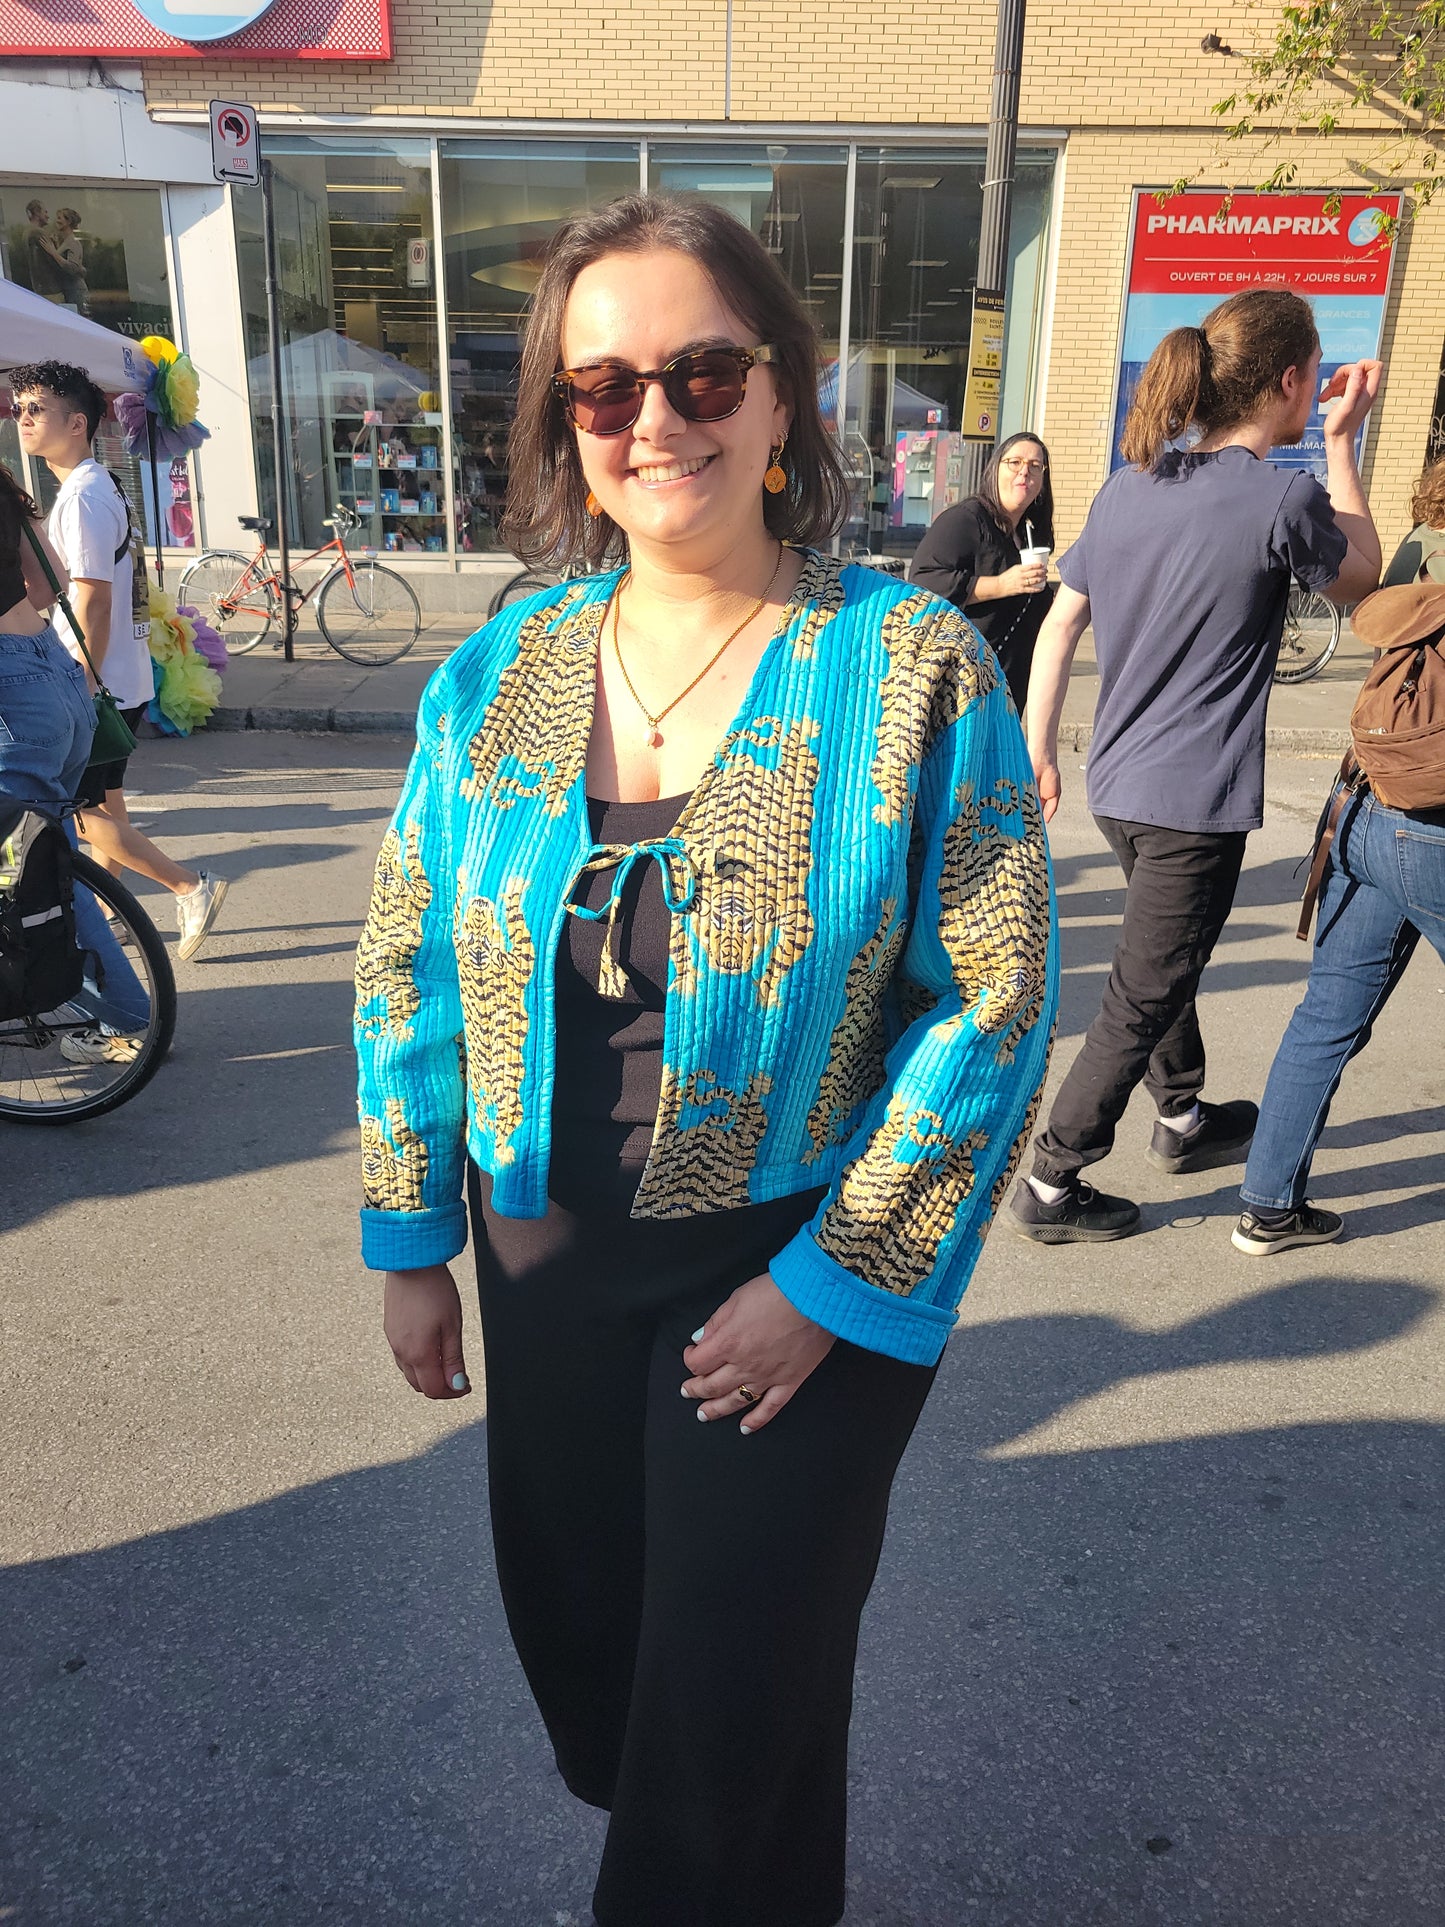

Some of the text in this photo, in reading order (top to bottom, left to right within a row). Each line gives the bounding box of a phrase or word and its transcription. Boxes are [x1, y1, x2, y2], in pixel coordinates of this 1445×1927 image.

[1147, 215, 1341, 236] PHARMAPRIX
[1169, 272, 1217, 282] OUVERT
[1218, 272, 1234, 282] DE
[1236, 272, 1251, 282] 9H
[1264, 272, 1285, 283] 22H
[1294, 273, 1301, 283] 7
[1303, 273, 1341, 283] JOURS
[1343, 273, 1367, 283] SUR
[1370, 273, 1377, 283] 7
[1323, 343, 1369, 353] OGIQUE
[1279, 441, 1326, 451] MINI-MAR
